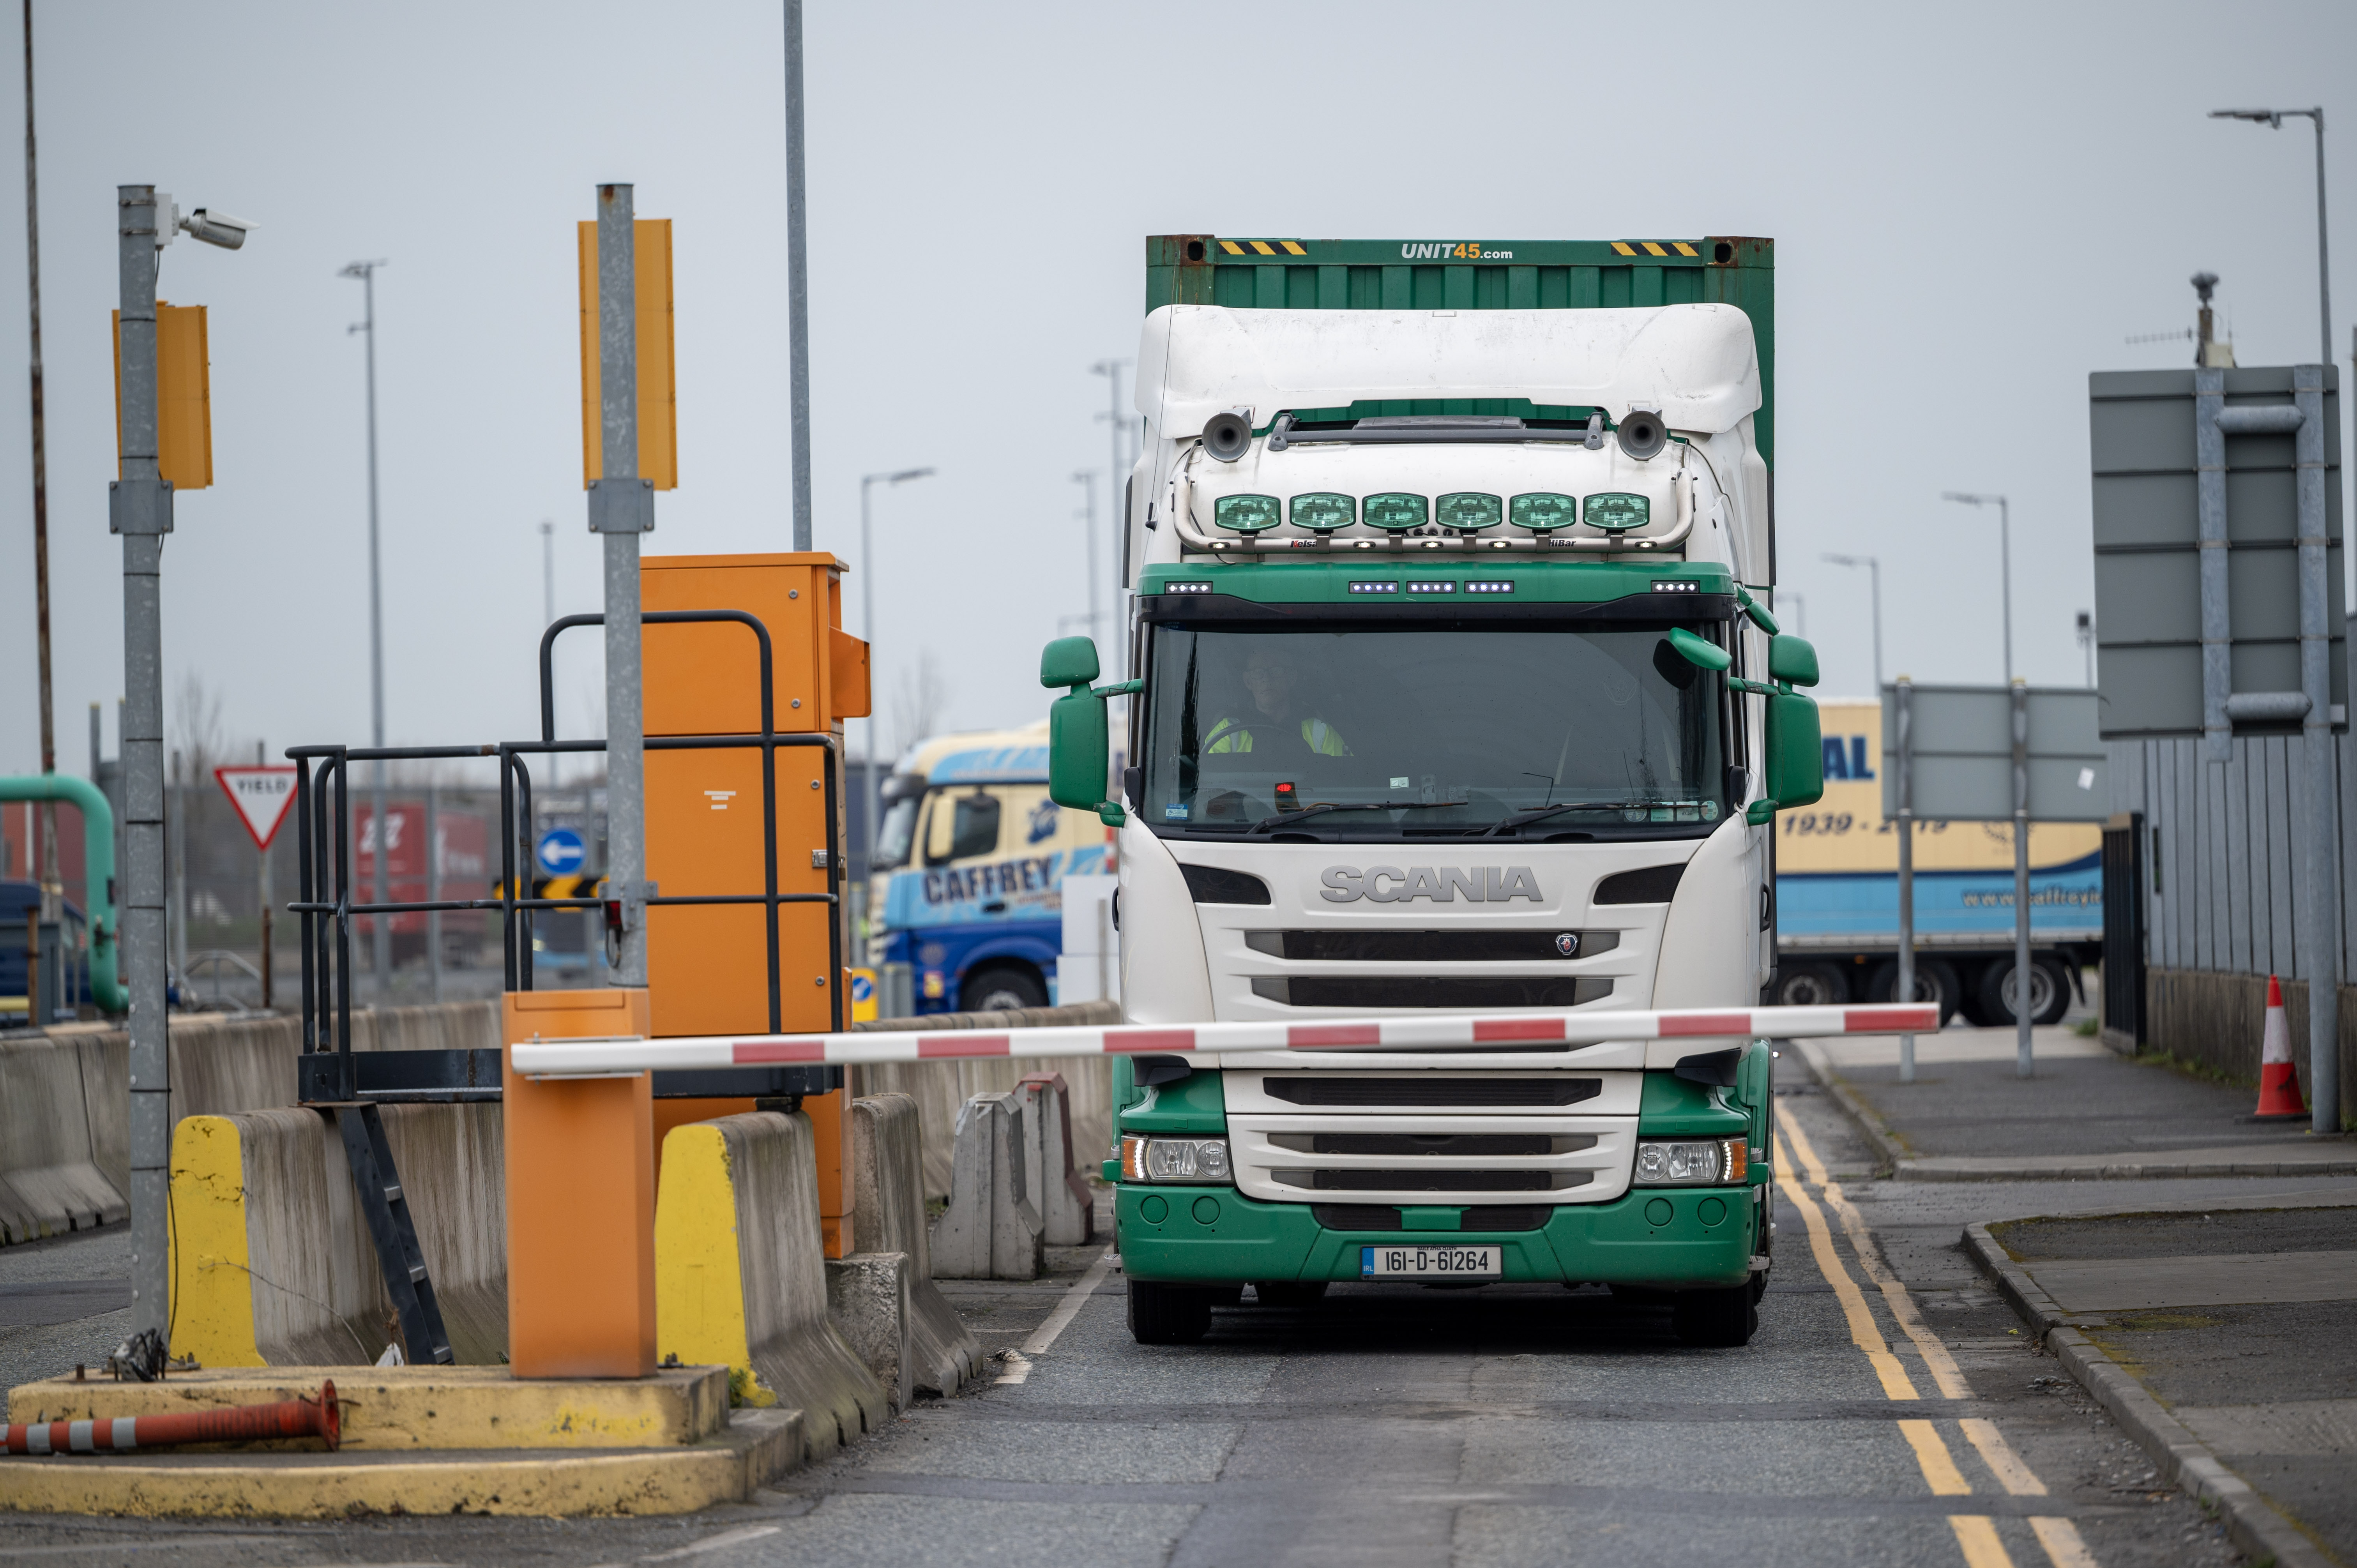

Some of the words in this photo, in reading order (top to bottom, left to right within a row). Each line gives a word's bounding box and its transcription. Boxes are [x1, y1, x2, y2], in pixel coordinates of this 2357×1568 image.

[1401, 243, 1512, 259] UNIT45.com
[236, 779, 288, 794] YIELD
[1877, 820, 1949, 835] 219
[922, 856, 1052, 906] CAFFREY
[1320, 865, 1543, 902] SCANIA
[1386, 1251, 1488, 1271] 161-D-61264
